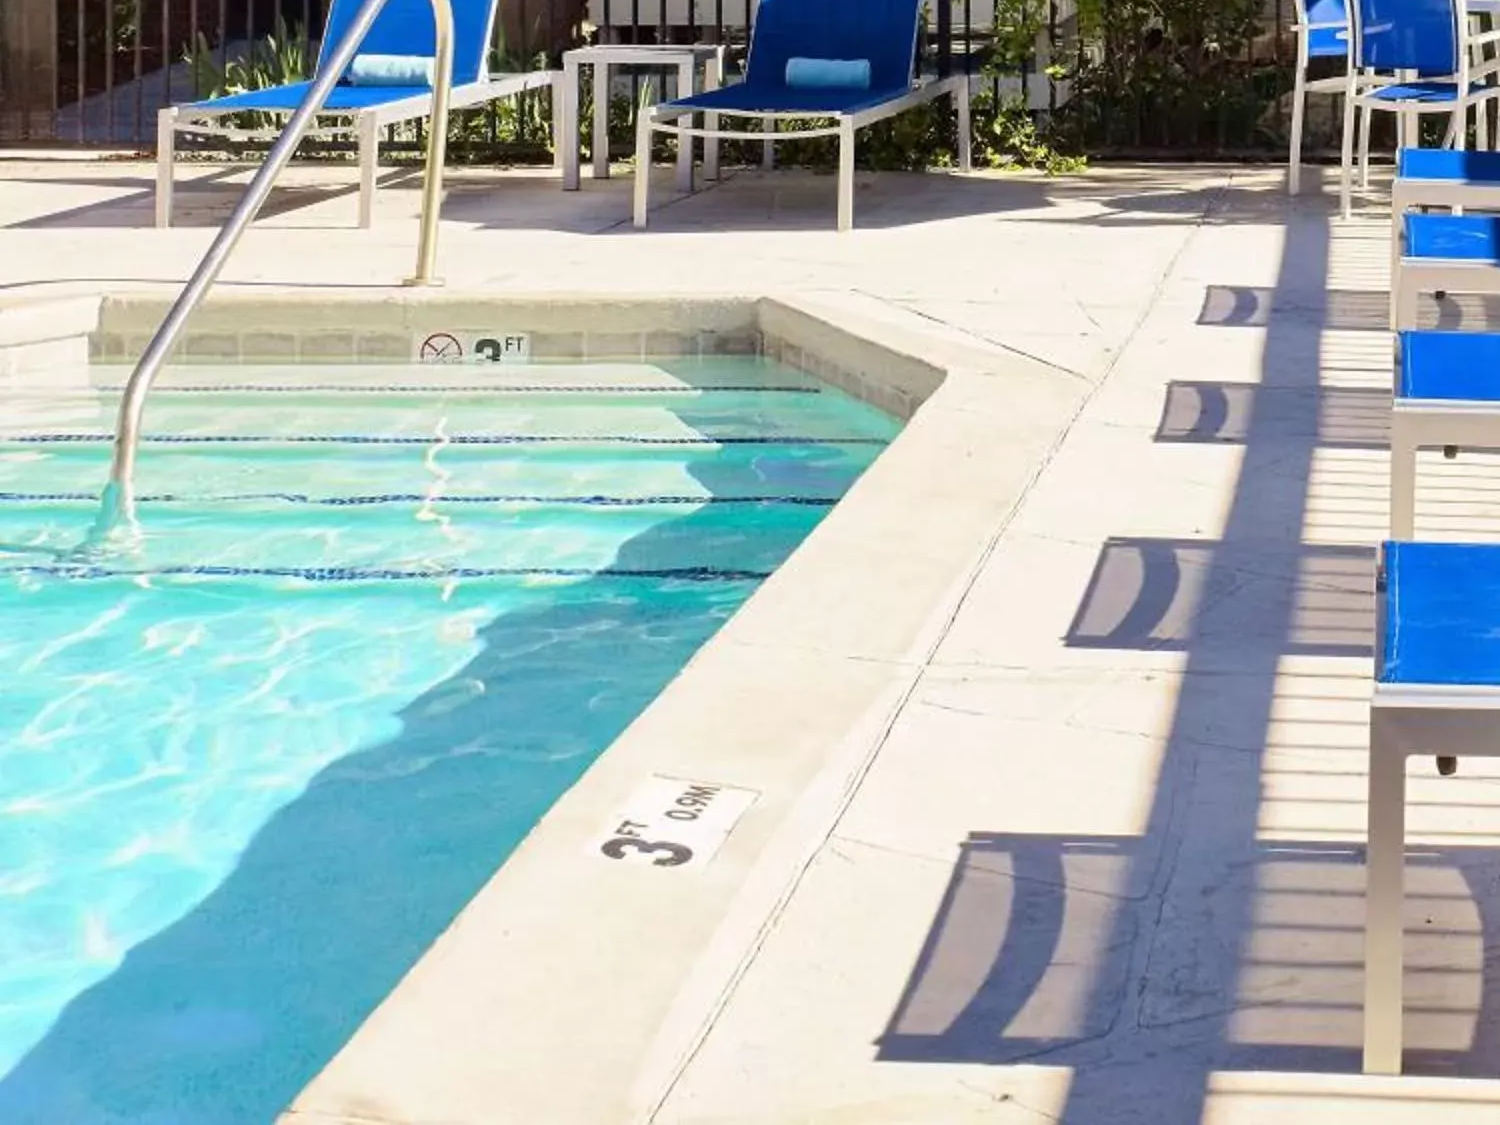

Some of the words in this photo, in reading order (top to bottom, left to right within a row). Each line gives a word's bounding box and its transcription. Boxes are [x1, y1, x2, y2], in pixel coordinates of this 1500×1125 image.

[505, 336, 524, 352] FT
[664, 784, 721, 822] 0.9M
[614, 819, 649, 838] FT
[601, 837, 693, 867] 3
